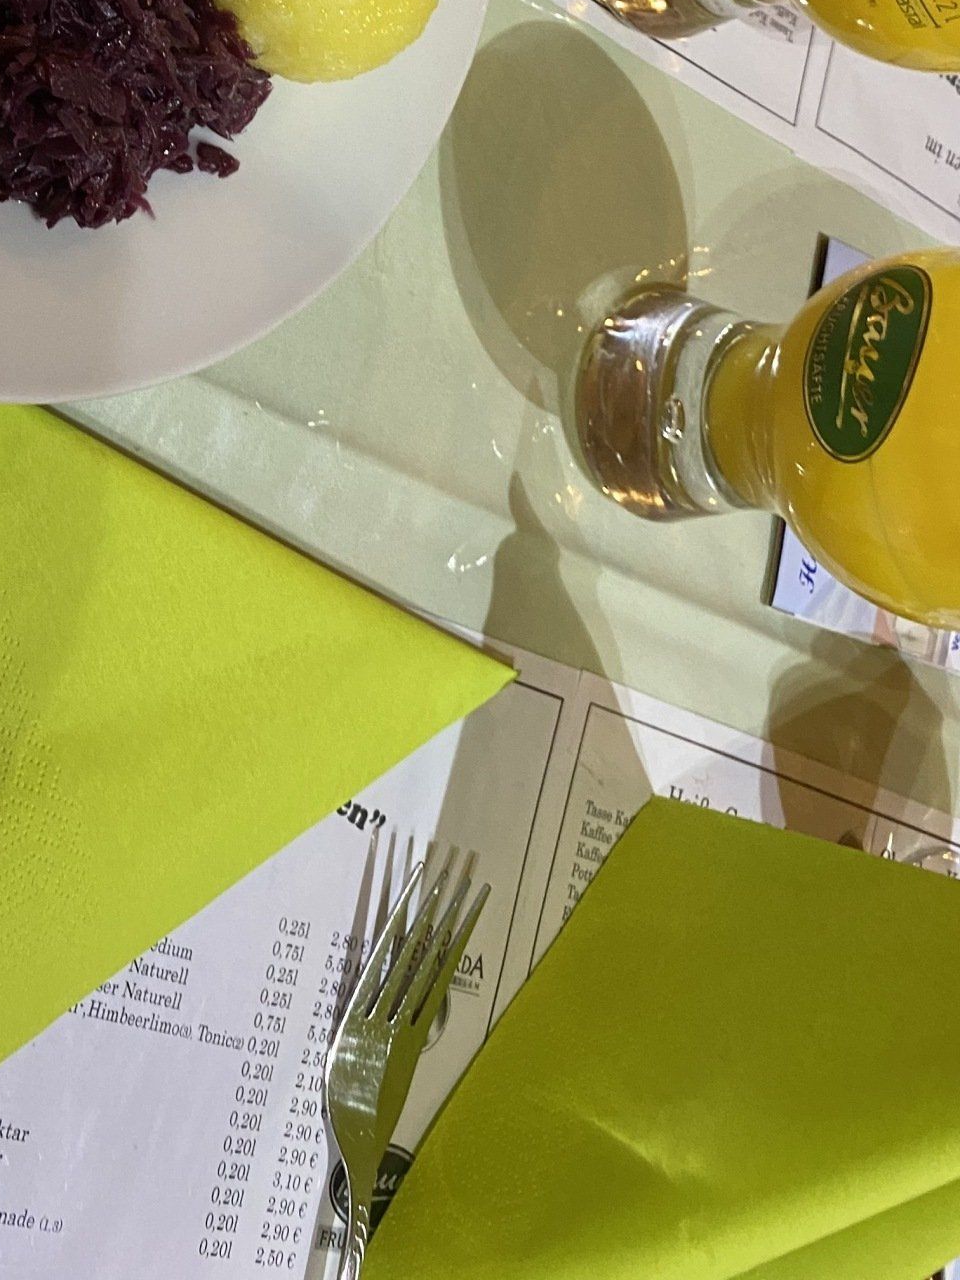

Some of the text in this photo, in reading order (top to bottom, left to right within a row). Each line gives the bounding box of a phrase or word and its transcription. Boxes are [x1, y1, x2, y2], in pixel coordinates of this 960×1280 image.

[922, 133, 942, 165] im
[849, 275, 914, 438] Bauer
[581, 821, 612, 844] Kaffee
[278, 916, 311, 939] 0,25l
[330, 931, 358, 951] 2,80
[150, 937, 193, 961] edium
[266, 964, 299, 986] 0,25l
[272, 940, 305, 962] 0,75l
[128, 958, 189, 986] Naturell
[260, 988, 293, 1010] 0,25l
[121, 980, 183, 1010] Naturell
[253, 1012, 287, 1034] 0,75l
[247, 1036, 280, 1058] 0,20l
[241, 1061, 274, 1082] 0,20l
[235, 1086, 268, 1107] 0,20l
[229, 1111, 262, 1132] 0,20l
[283, 1122, 312, 1143] 2,90
[315, 1126, 325, 1145] €
[223, 1136, 256, 1157] 0,20l
[277, 1146, 307, 1167] 2,90
[309, 1150, 319, 1169] €
[217, 1161, 250, 1182] 0,20l
[272, 1171, 301, 1192] 3,10
[303, 1175, 314, 1194] €
[211, 1186, 244, 1207] 0,20l
[266, 1197, 296, 1218] 2,90
[298, 1201, 308, 1219] €
[205, 1212, 238, 1233] 0,20l
[260, 1222, 290, 1243] 2,90
[292, 1226, 302, 1245] €
[199, 1238, 233, 1259] 0,20l
[254, 1247, 284, 1269] 2,50
[286, 1251, 297, 1270] €
